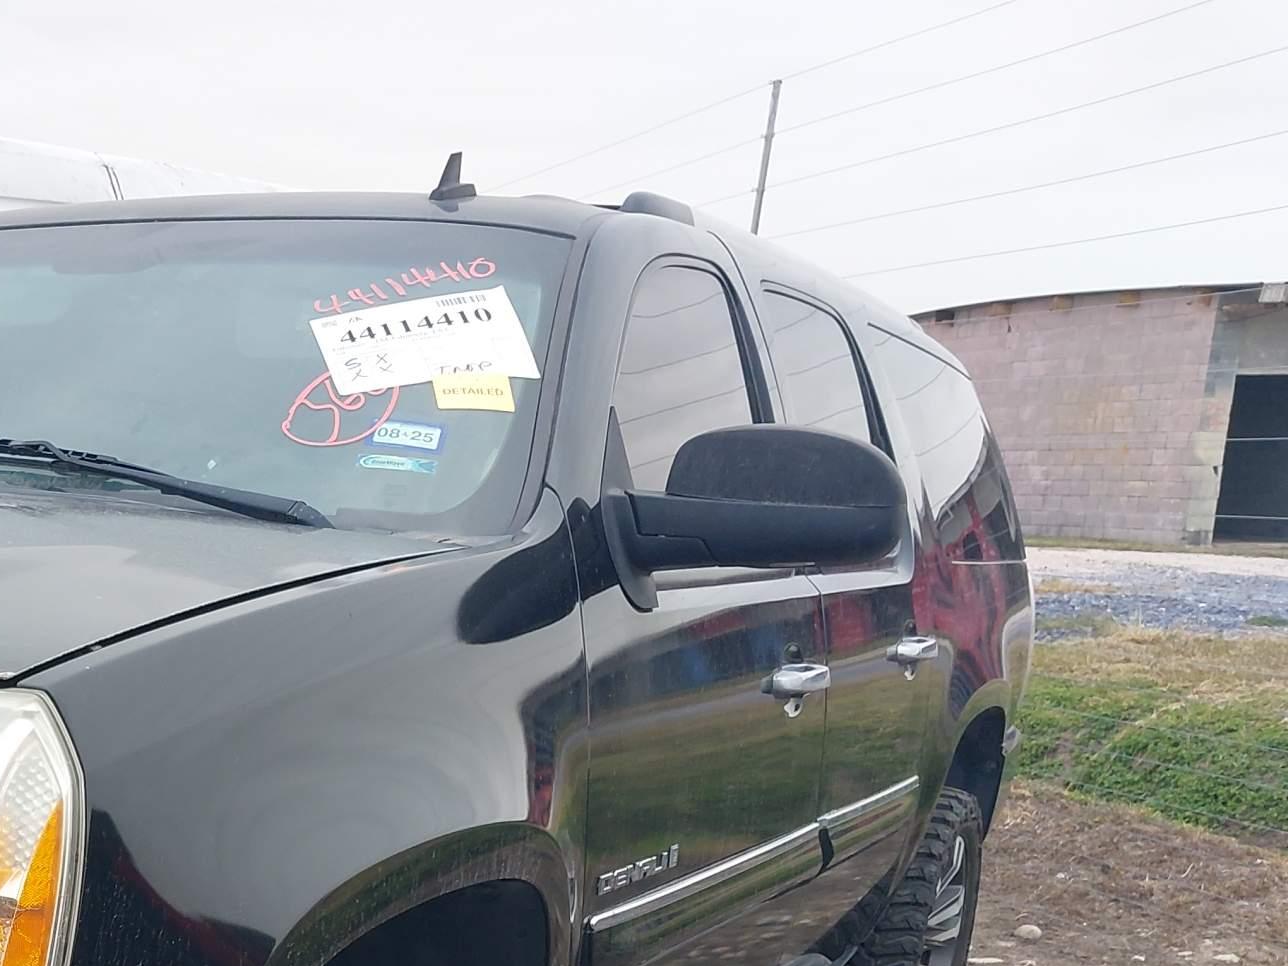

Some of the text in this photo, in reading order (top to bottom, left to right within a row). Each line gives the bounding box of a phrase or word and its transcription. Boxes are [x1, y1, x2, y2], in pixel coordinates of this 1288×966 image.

[313, 257, 497, 314] 44114410
[340, 307, 492, 344] 44114410
[442, 386, 503, 397] DETAILED
[377, 427, 434, 443] 08 25
